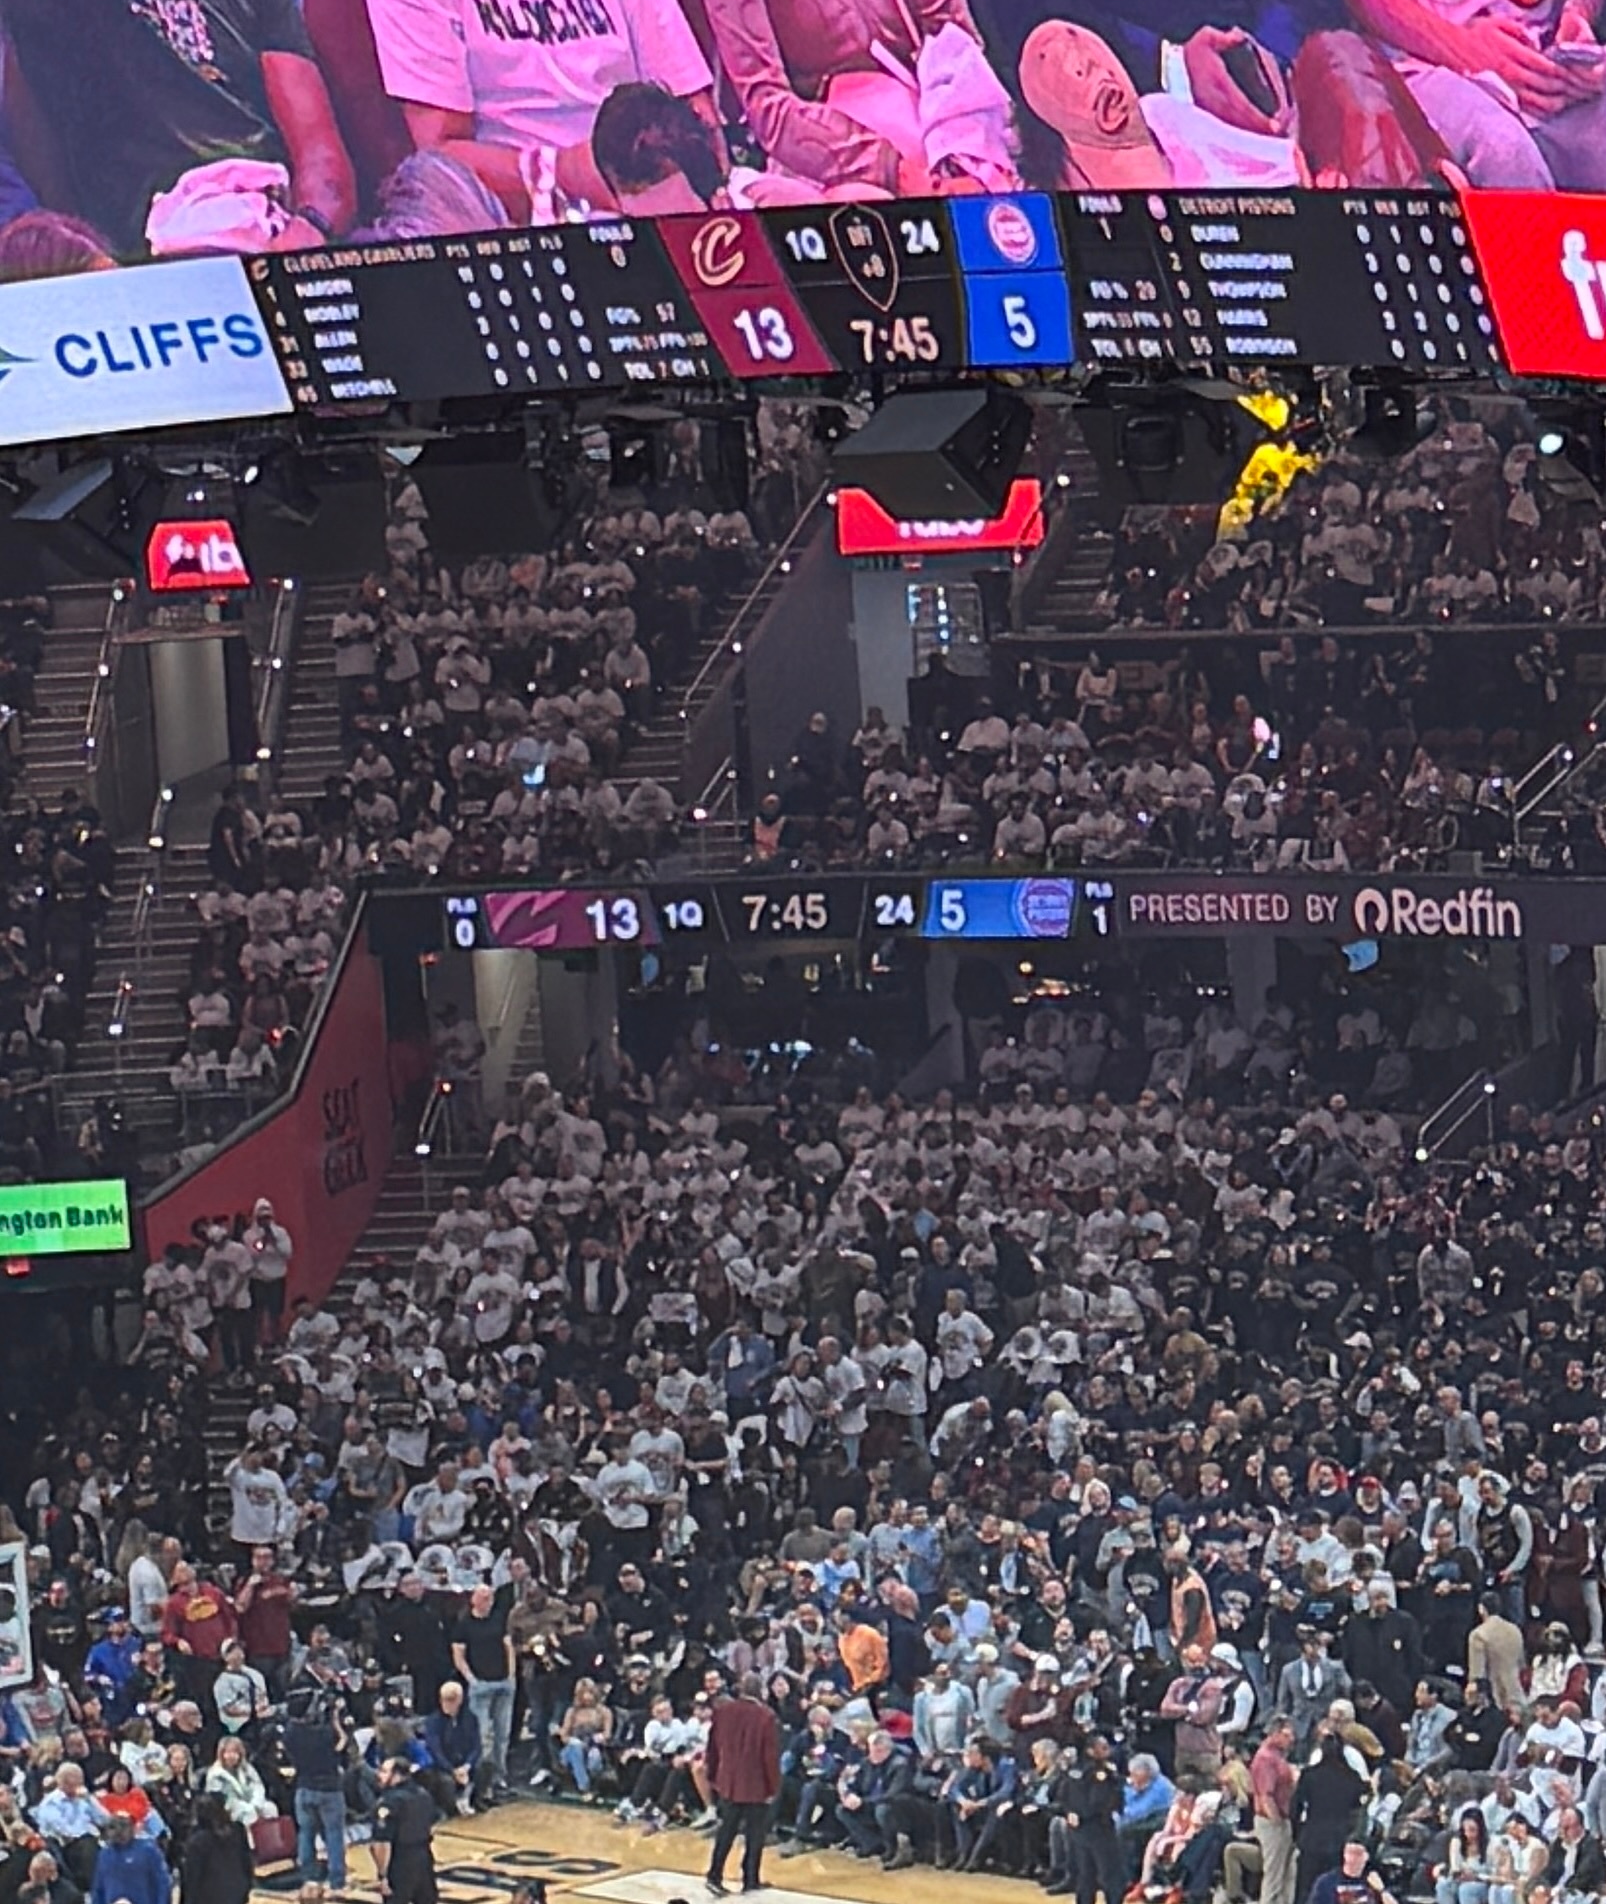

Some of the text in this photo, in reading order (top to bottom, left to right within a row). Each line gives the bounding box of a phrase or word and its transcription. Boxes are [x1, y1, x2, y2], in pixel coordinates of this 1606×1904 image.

[785, 218, 941, 261] 1Q 24
[54, 313, 264, 379] CLIFFS
[733, 306, 796, 363] 13
[850, 316, 940, 364] 7:45
[1003, 295, 1036, 349] 5
[456, 918, 474, 947] 0
[585, 889, 965, 942] 13 1Q 7:45 24 5
[1092, 906, 1108, 936] 1
[1129, 888, 1523, 938] PRESENTED BY Redfin
[65, 1203, 124, 1229] Bank
